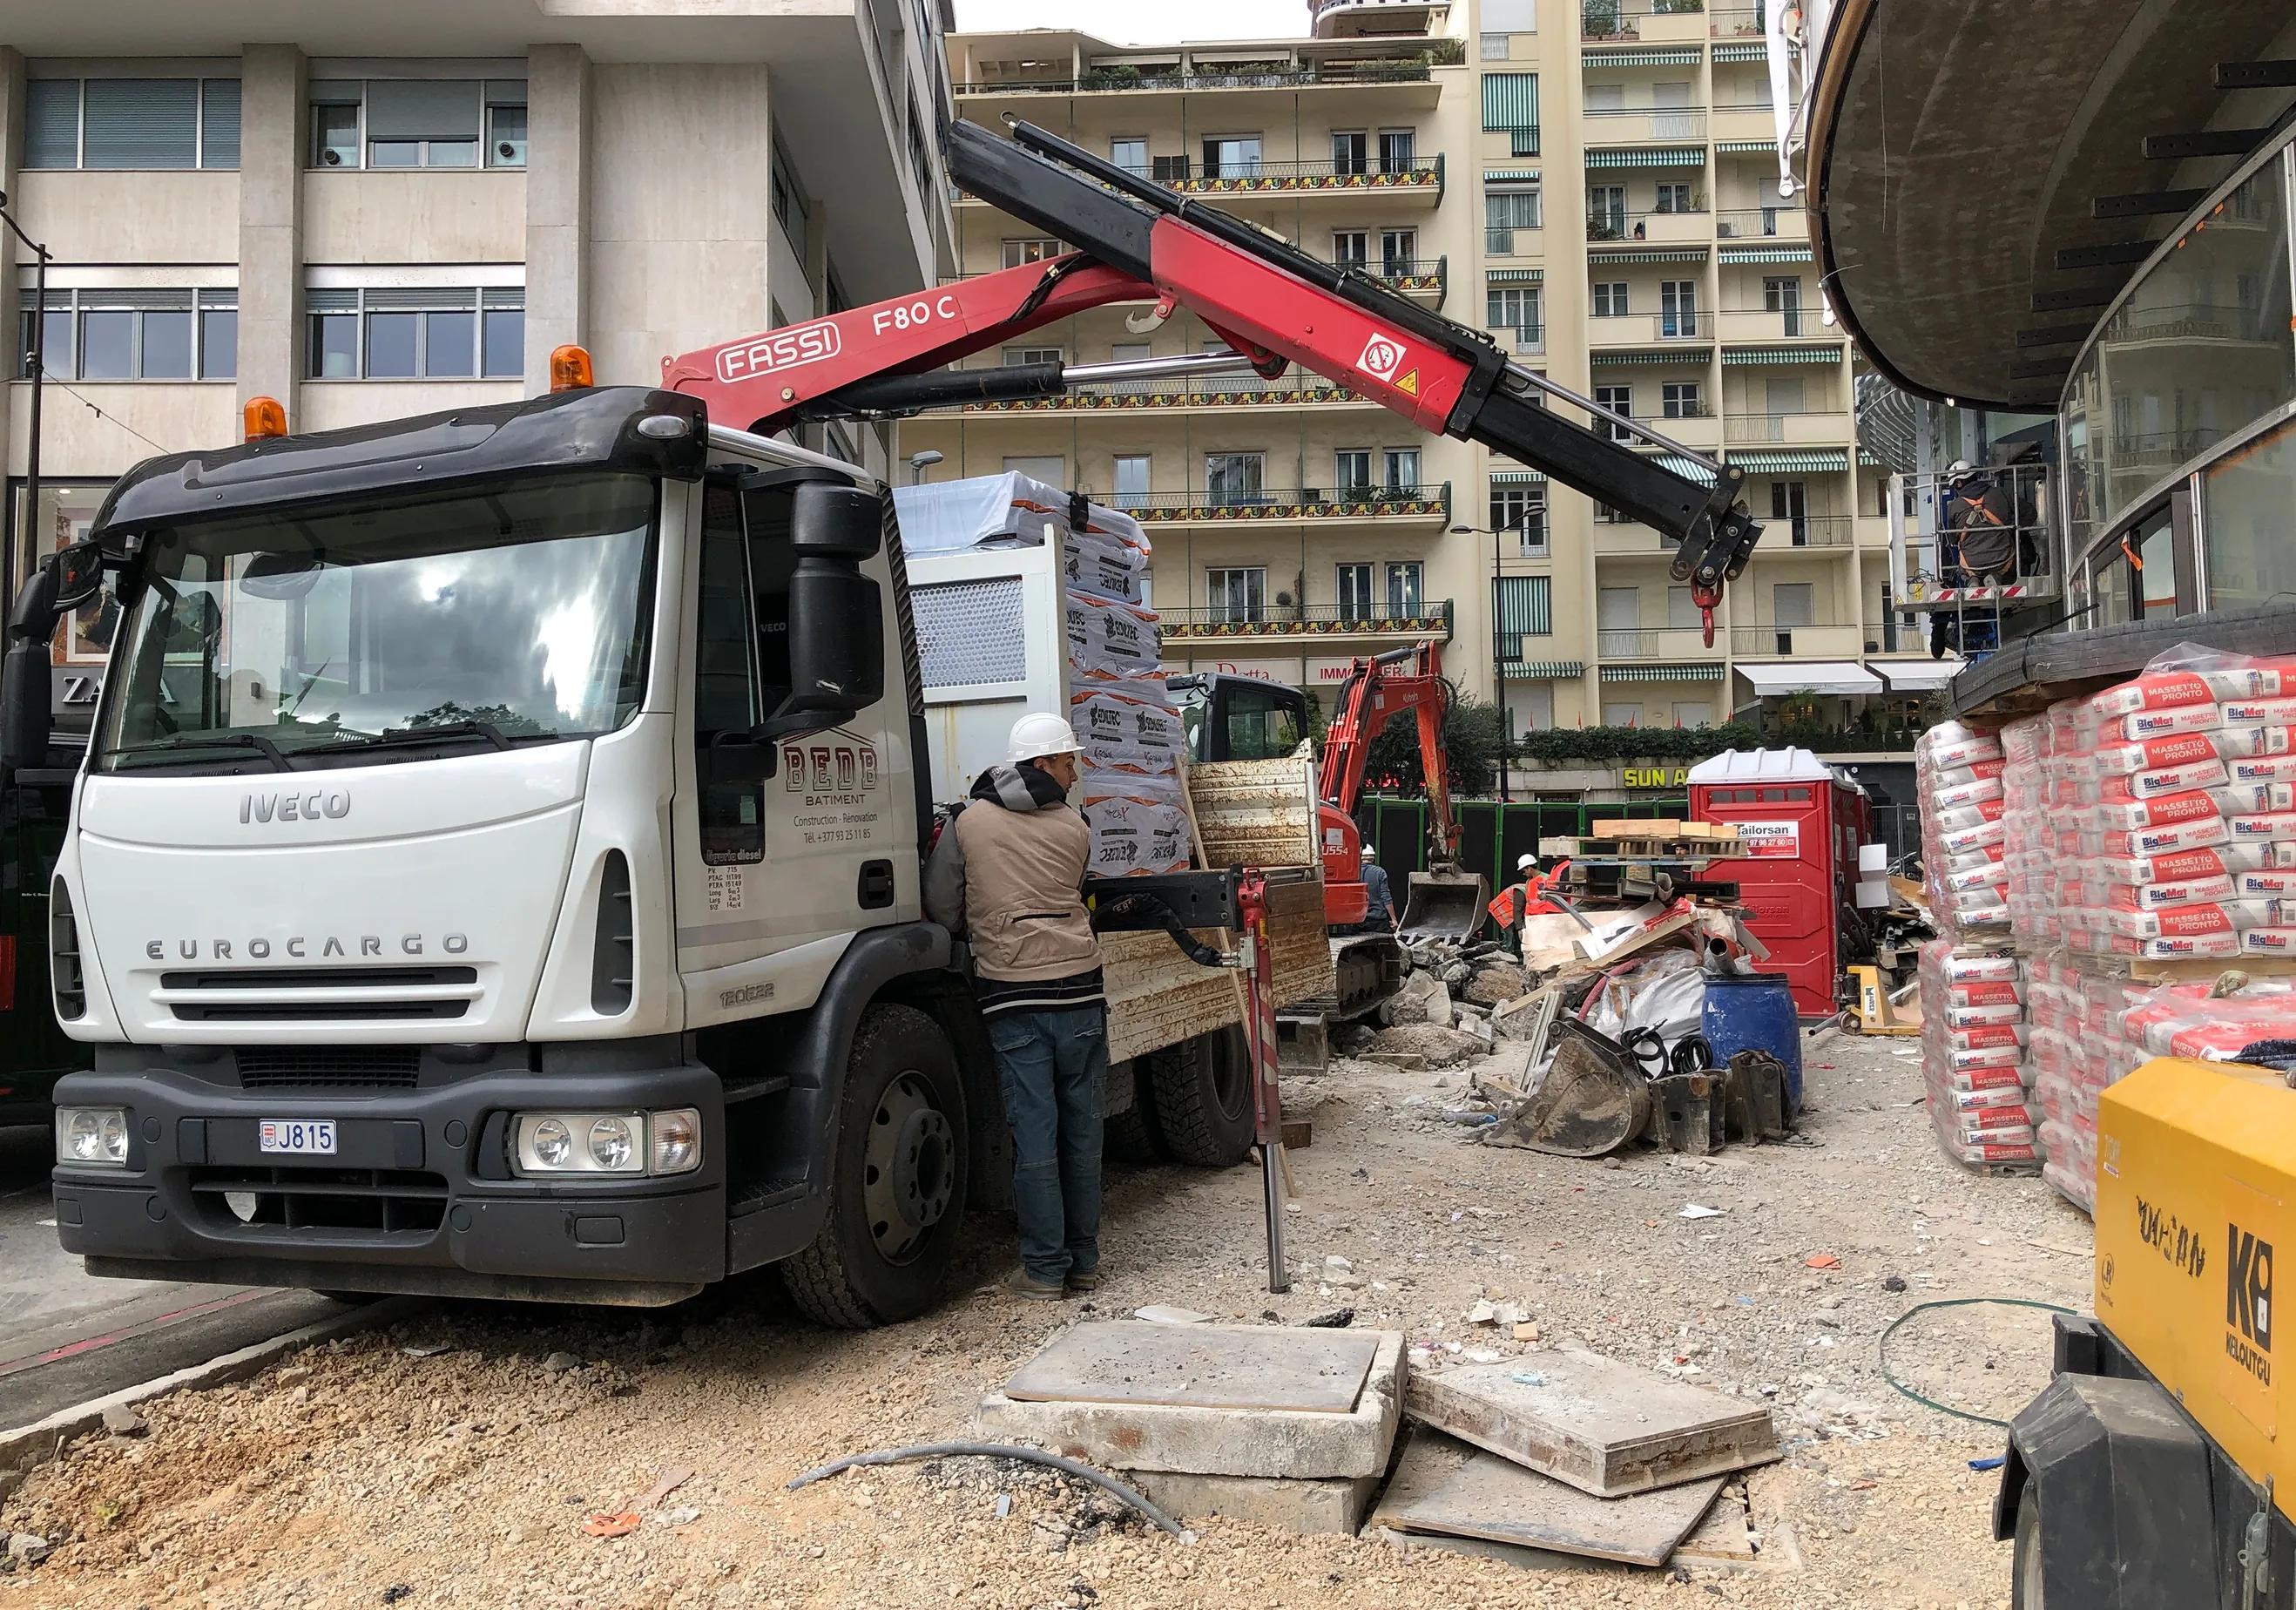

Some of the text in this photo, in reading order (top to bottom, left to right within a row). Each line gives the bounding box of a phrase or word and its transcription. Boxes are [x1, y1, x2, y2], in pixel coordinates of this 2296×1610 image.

[874, 295, 956, 335] F80 C
[725, 328, 832, 376] FASSI
[2148, 683, 2202, 696] MASSETTO
[2162, 690, 2203, 701] PRONTO
[2228, 707, 2265, 718] BigMat
[2137, 716, 2174, 728] BigMat
[2151, 740, 2205, 754] MASSETTO
[2164, 748, 2206, 760] PRONTO
[784, 747, 878, 792] BEDB
[2238, 765, 2275, 775] BigMat
[1624, 768, 1665, 788] SUN
[2144, 775, 2180, 786] BigMat
[240, 789, 351, 823] IVECO
[806, 795, 866, 806] BATIMENT
[2153, 798, 2208, 813] MASSETTO
[2167, 806, 2209, 818] PRONTO
[793, 814, 838, 827] Construction
[2235, 822, 2272, 831] BigMat
[836, 830, 844, 841] 93
[2143, 834, 2178, 846] BigMat
[738, 848, 761, 860] diesel
[2158, 856, 2213, 869] MASSETTO
[2172, 862, 2214, 875] PRONTO
[2246, 878, 2285, 890] BigMat
[2150, 889, 2187, 899] BigMat
[2164, 912, 2219, 925] MASSETTO
[2178, 920, 2221, 931] PRONTO
[2249, 933, 2286, 944] BigMat
[146, 933, 468, 959] EUROCARGO
[2157, 941, 2193, 951] BigMat
[1973, 1035, 2013, 1044] MASSETTO
[279, 1125, 331, 1149] J815
